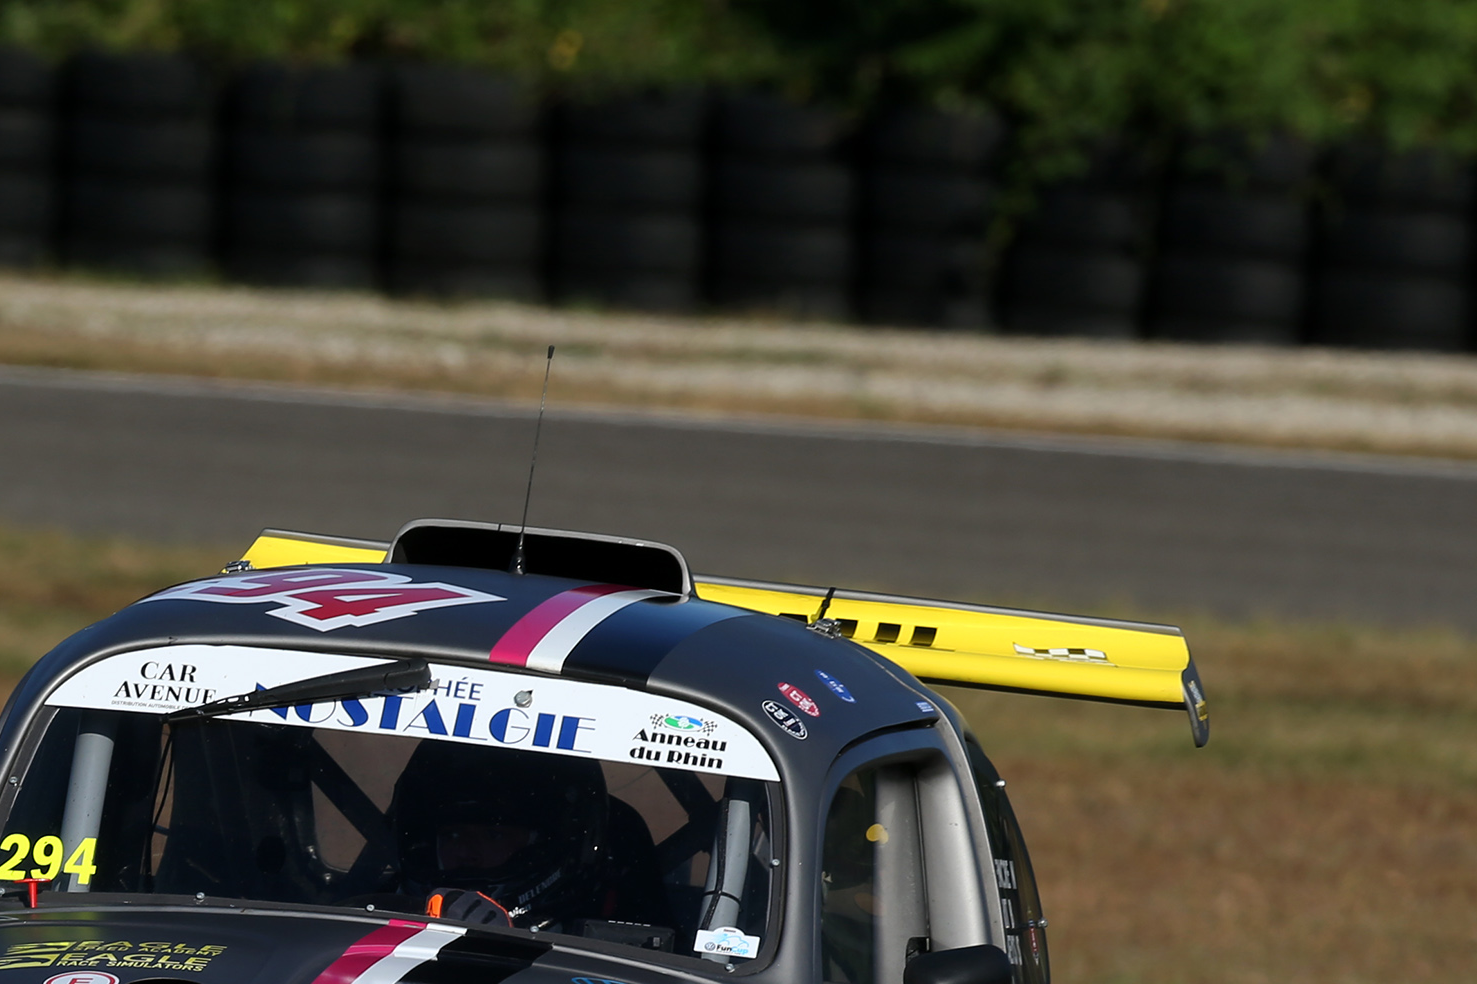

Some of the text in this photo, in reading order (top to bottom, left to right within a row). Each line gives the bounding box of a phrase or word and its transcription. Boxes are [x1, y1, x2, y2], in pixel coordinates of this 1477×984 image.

[140, 661, 197, 683] CAR
[113, 681, 216, 705] AVENUE
[632, 728, 727, 752] Anneau
[629, 746, 723, 769] du Rhin
[56, 960, 208, 972] RACE SIMULATORS
[60, 952, 212, 966] EAGLE
